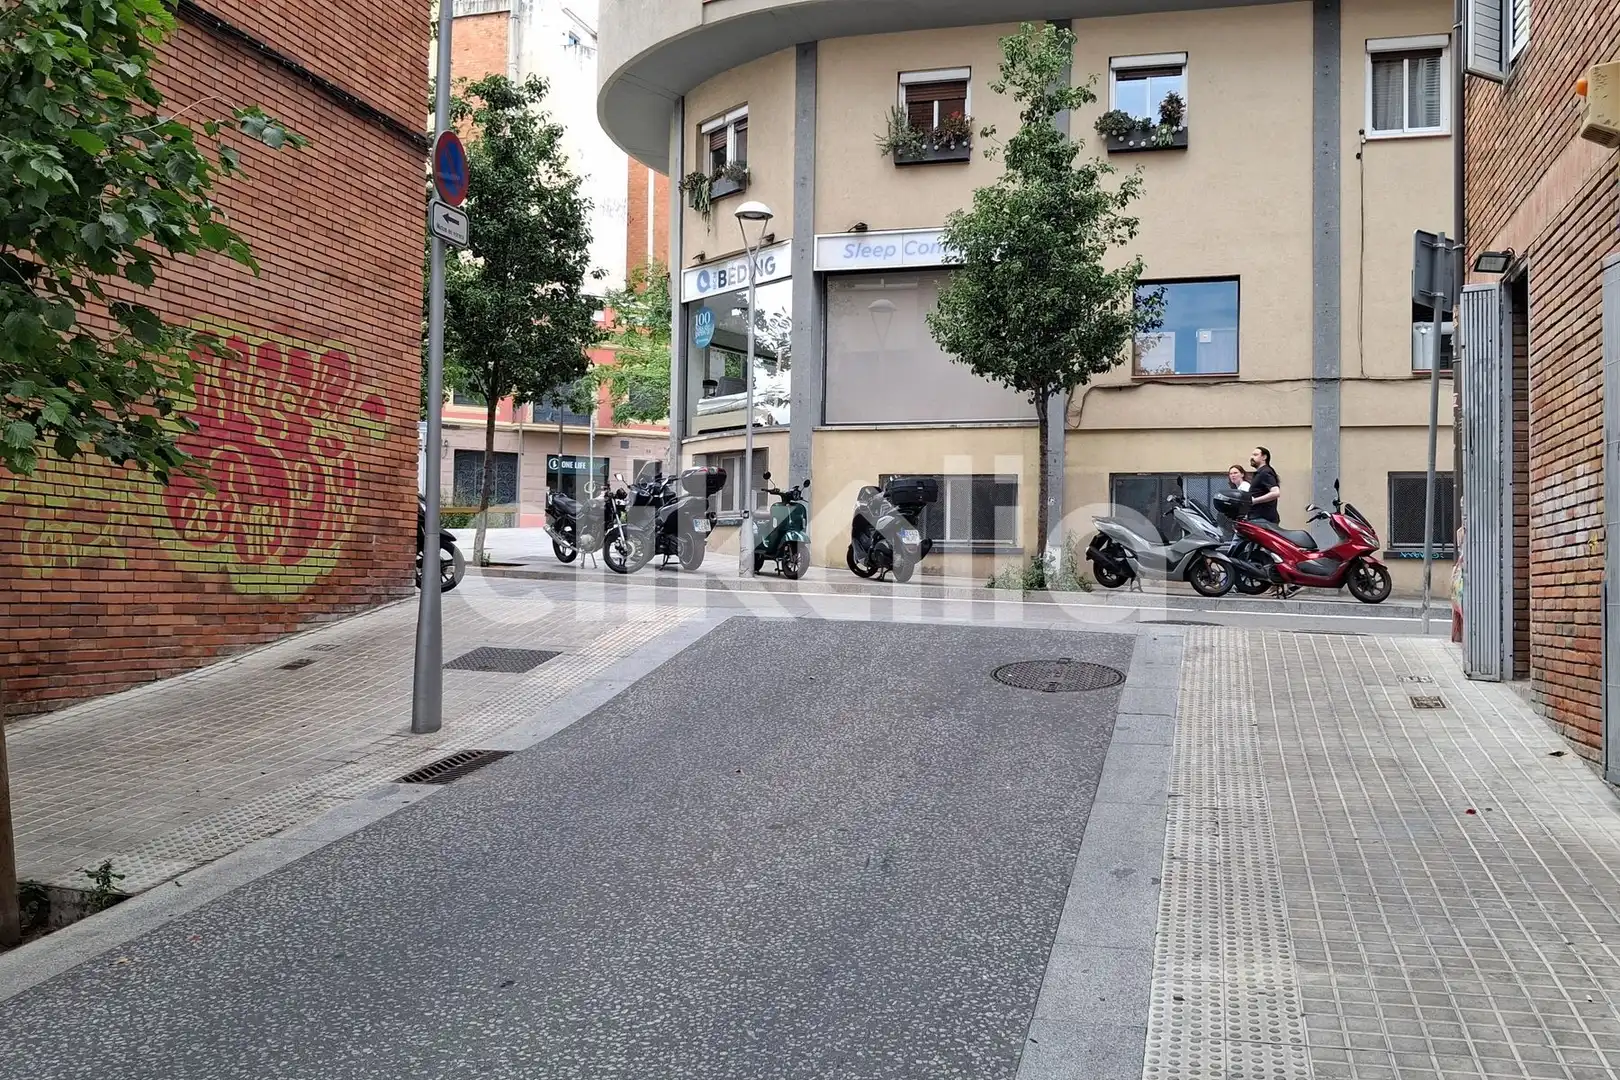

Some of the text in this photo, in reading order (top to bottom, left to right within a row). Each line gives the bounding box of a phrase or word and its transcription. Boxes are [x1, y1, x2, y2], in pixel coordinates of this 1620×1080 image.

[843, 242, 897, 260] Sleep
[717, 255, 776, 289] BEDNG
[695, 311, 711, 326] 100
[561, 460, 574, 469] ONE
[574, 461, 587, 469] LIFE
